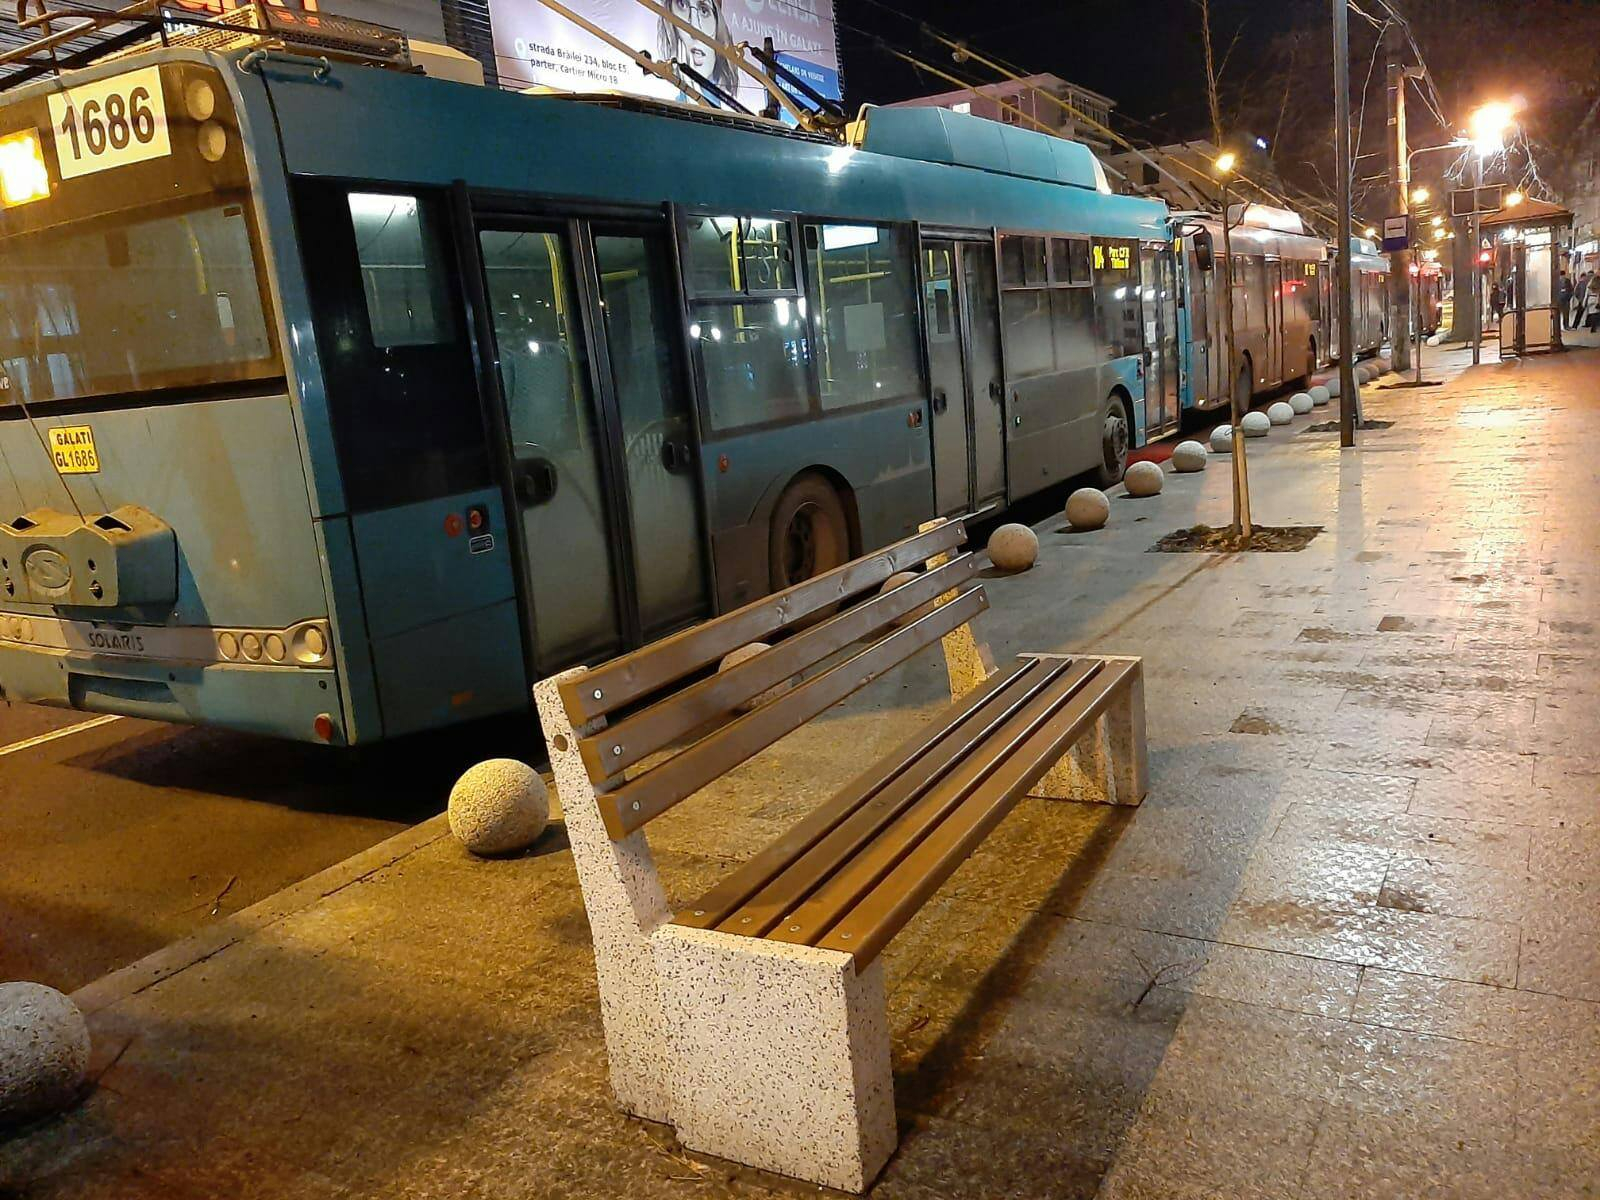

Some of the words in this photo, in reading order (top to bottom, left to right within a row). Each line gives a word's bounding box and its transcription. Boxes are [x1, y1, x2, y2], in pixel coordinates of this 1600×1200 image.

[528, 42, 555, 56] strada
[601, 59, 617, 71] bloc
[530, 58, 558, 73] parter,
[587, 69, 608, 82] Micro
[61, 86, 155, 160] 1686
[56, 431, 91, 446] GALATI
[88, 631, 145, 652] SOLARIS
